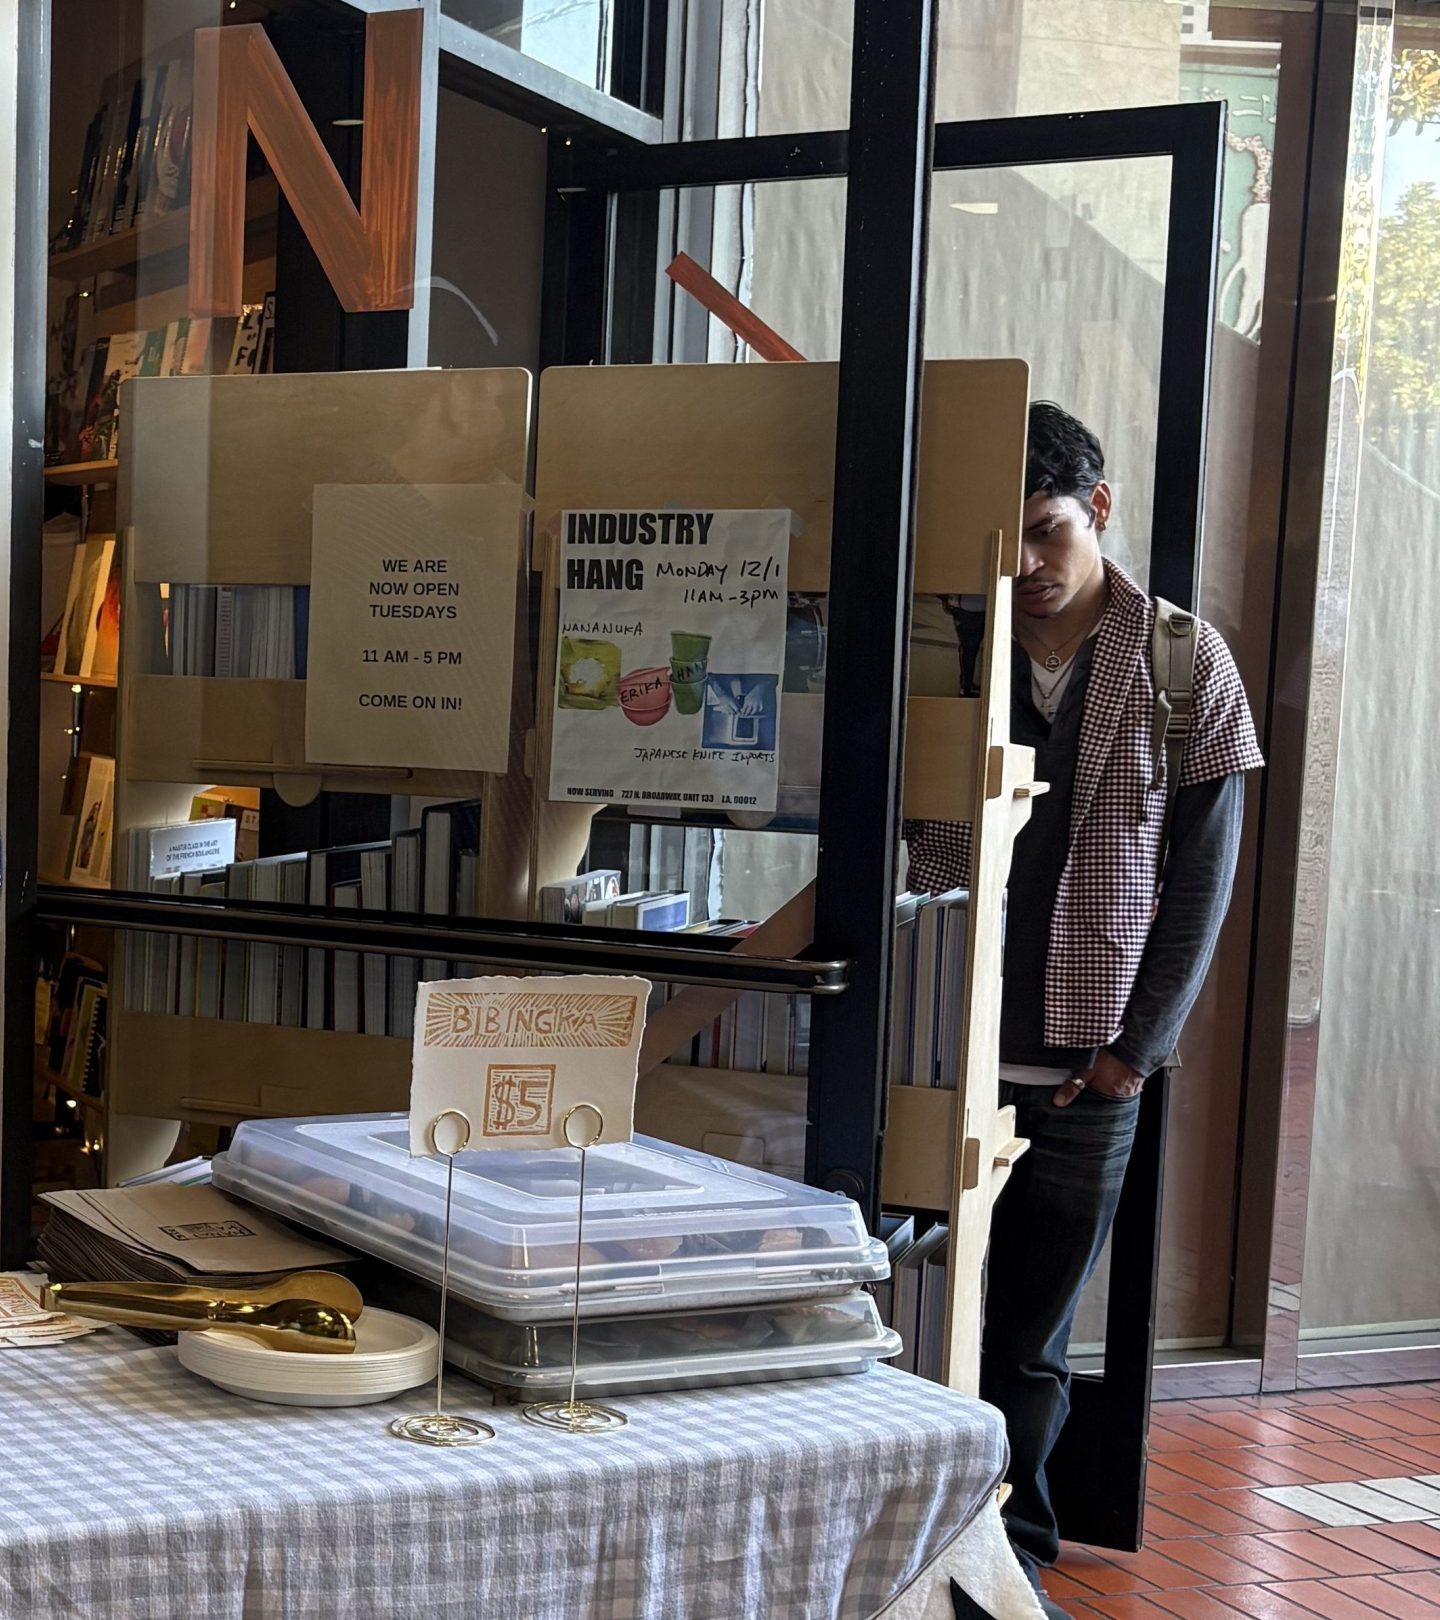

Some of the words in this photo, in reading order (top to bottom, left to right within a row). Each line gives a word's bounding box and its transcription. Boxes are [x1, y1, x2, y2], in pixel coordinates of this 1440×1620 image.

[190, 9, 424, 318] N
[567, 513, 713, 545] INDUSTRY
[382, 559, 408, 573] WE
[412, 560, 448, 573] ARE
[740, 556, 780, 581] 12/1
[567, 559, 643, 590] HANG
[369, 582, 408, 595] NOW
[413, 582, 460, 596] OPEN
[369, 604, 457, 619] TUESDAYS
[561, 621, 644, 637] NANANUKA
[362, 650, 378, 663] 11
[384, 651, 408, 663] AM
[423, 652, 432, 664] 5
[437, 652, 462, 665] PM
[620, 677, 663, 703] ERIKA
[359, 694, 408, 708] COME
[412, 696, 436, 709] ON
[441, 697, 462, 710] IN!
[633, 748, 688, 762] JAPANESE
[692, 749, 726, 760] KNIFE
[567, 787, 584, 796] NOW
[585, 788, 614, 797] SERVING
[621, 790, 633, 799] 727
[683, 793, 700, 802] UNIT
[450, 1004, 598, 1037] BIBINGKA
[493, 1075, 544, 1131] $5
